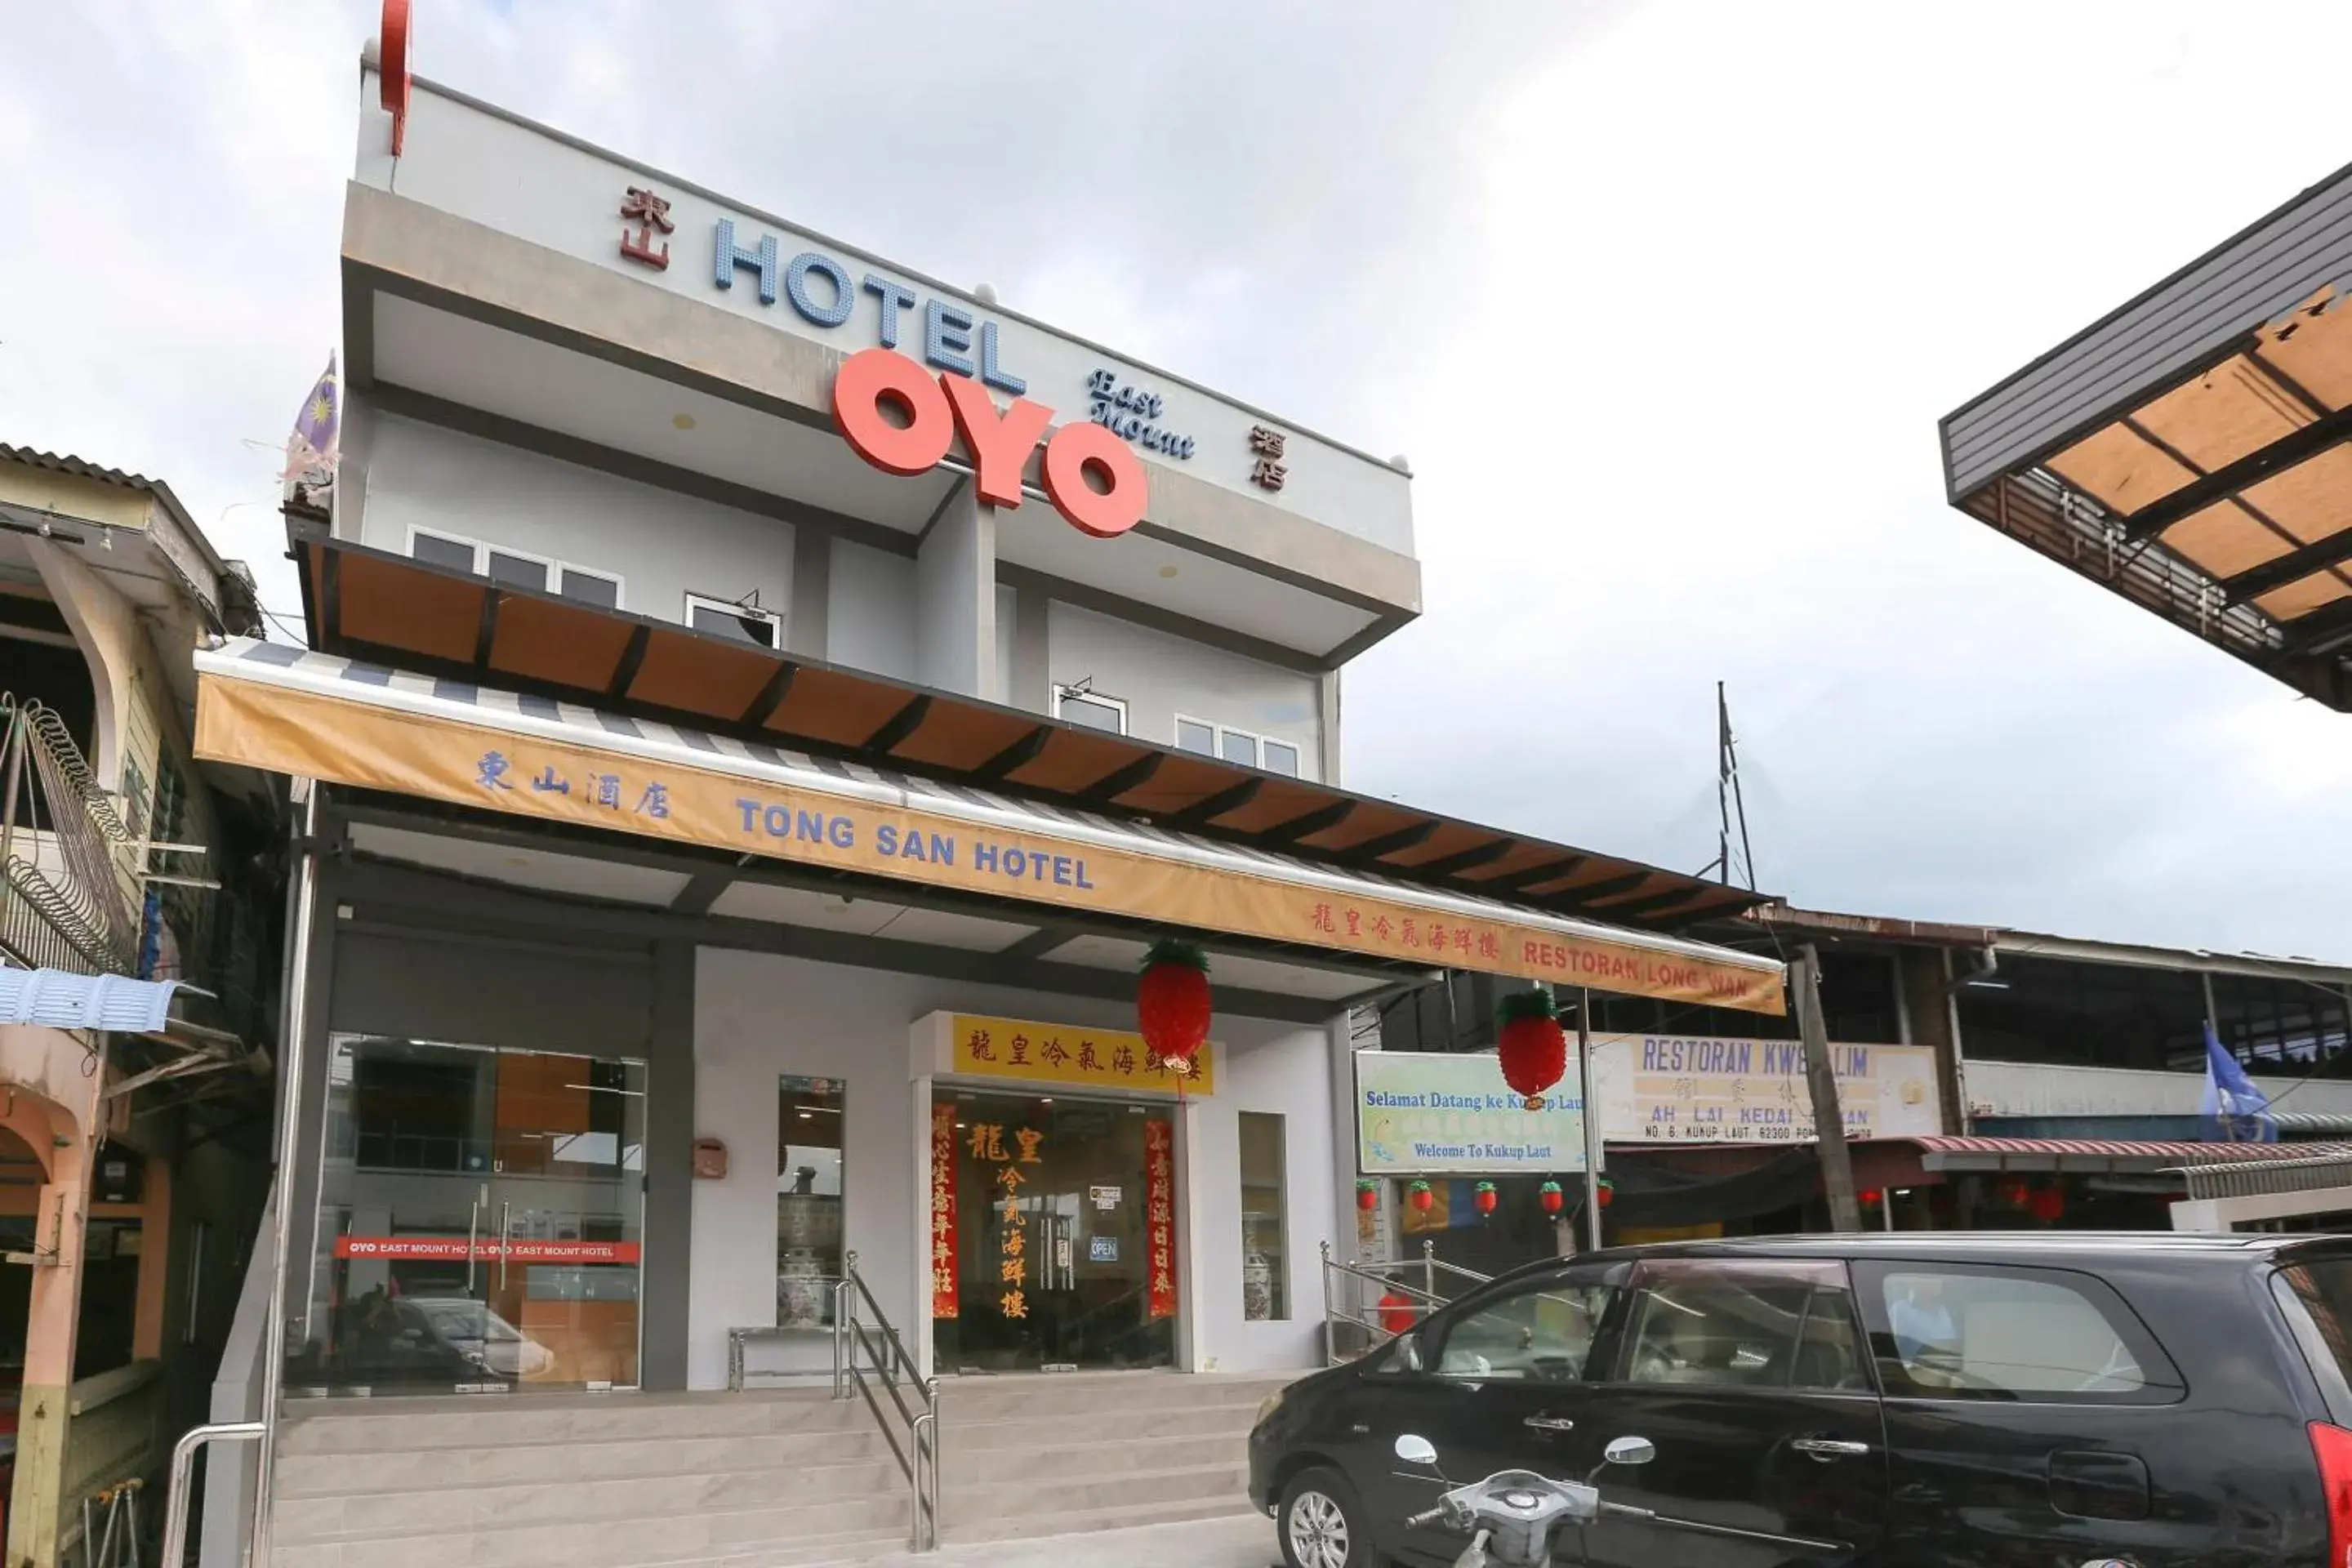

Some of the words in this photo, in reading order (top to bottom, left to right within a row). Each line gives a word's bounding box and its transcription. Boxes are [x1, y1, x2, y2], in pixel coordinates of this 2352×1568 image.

[713, 216, 1027, 396] HOTEL
[1086, 366, 1163, 420] East
[833, 347, 1148, 539] OYO
[1090, 401, 1196, 461] Mount
[1250, 424, 1289, 492] 酒店
[474, 749, 674, 819] 東山酒店
[736, 797, 854, 849] TONG
[875, 825, 955, 866] SAN
[974, 841, 1094, 890] HOTEL
[1311, 902, 1499, 959] 龍皇冷氣海鮮樓
[1524, 941, 1638, 981] RESTORAN
[1647, 962, 1699, 989] LONG
[1643, 1038, 1752, 1074] RESTORAN
[1763, 1043, 1807, 1075] KWE
[1835, 1047, 1869, 1077] LIM
[1366, 1090, 1426, 1108] Selamat
[1430, 1091, 1482, 1111] Datang
[1486, 1093, 1503, 1108] ke
[1507, 1094, 1555, 1112] Kup
[1559, 1095, 1583, 1110] Lau
[1651, 1105, 1676, 1122] AH
[1694, 1107, 1723, 1123] LAI
[1740, 1107, 1793, 1125] KEDAI
[965, 1123, 1044, 1163] 龍皇
[1414, 1143, 1465, 1157] Welcome
[1468, 1144, 1482, 1157] To
[1486, 1144, 1523, 1160] Kukup
[1526, 1145, 1551, 1158] Laut
[350, 1243, 376, 1252] OYO
[381, 1244, 408, 1253] EAST
[411, 1245, 449, 1253] MOUNT
[452, 1246, 487, 1255] HOEL
[516, 1246, 541, 1255] EAST
[545, 1247, 580, 1255] MOUNT
[581, 1248, 613, 1257] HOTEL
[996, 1166, 1029, 1319] 冷氣海鮮樓
[1091, 1242, 1116, 1255] OPEN
